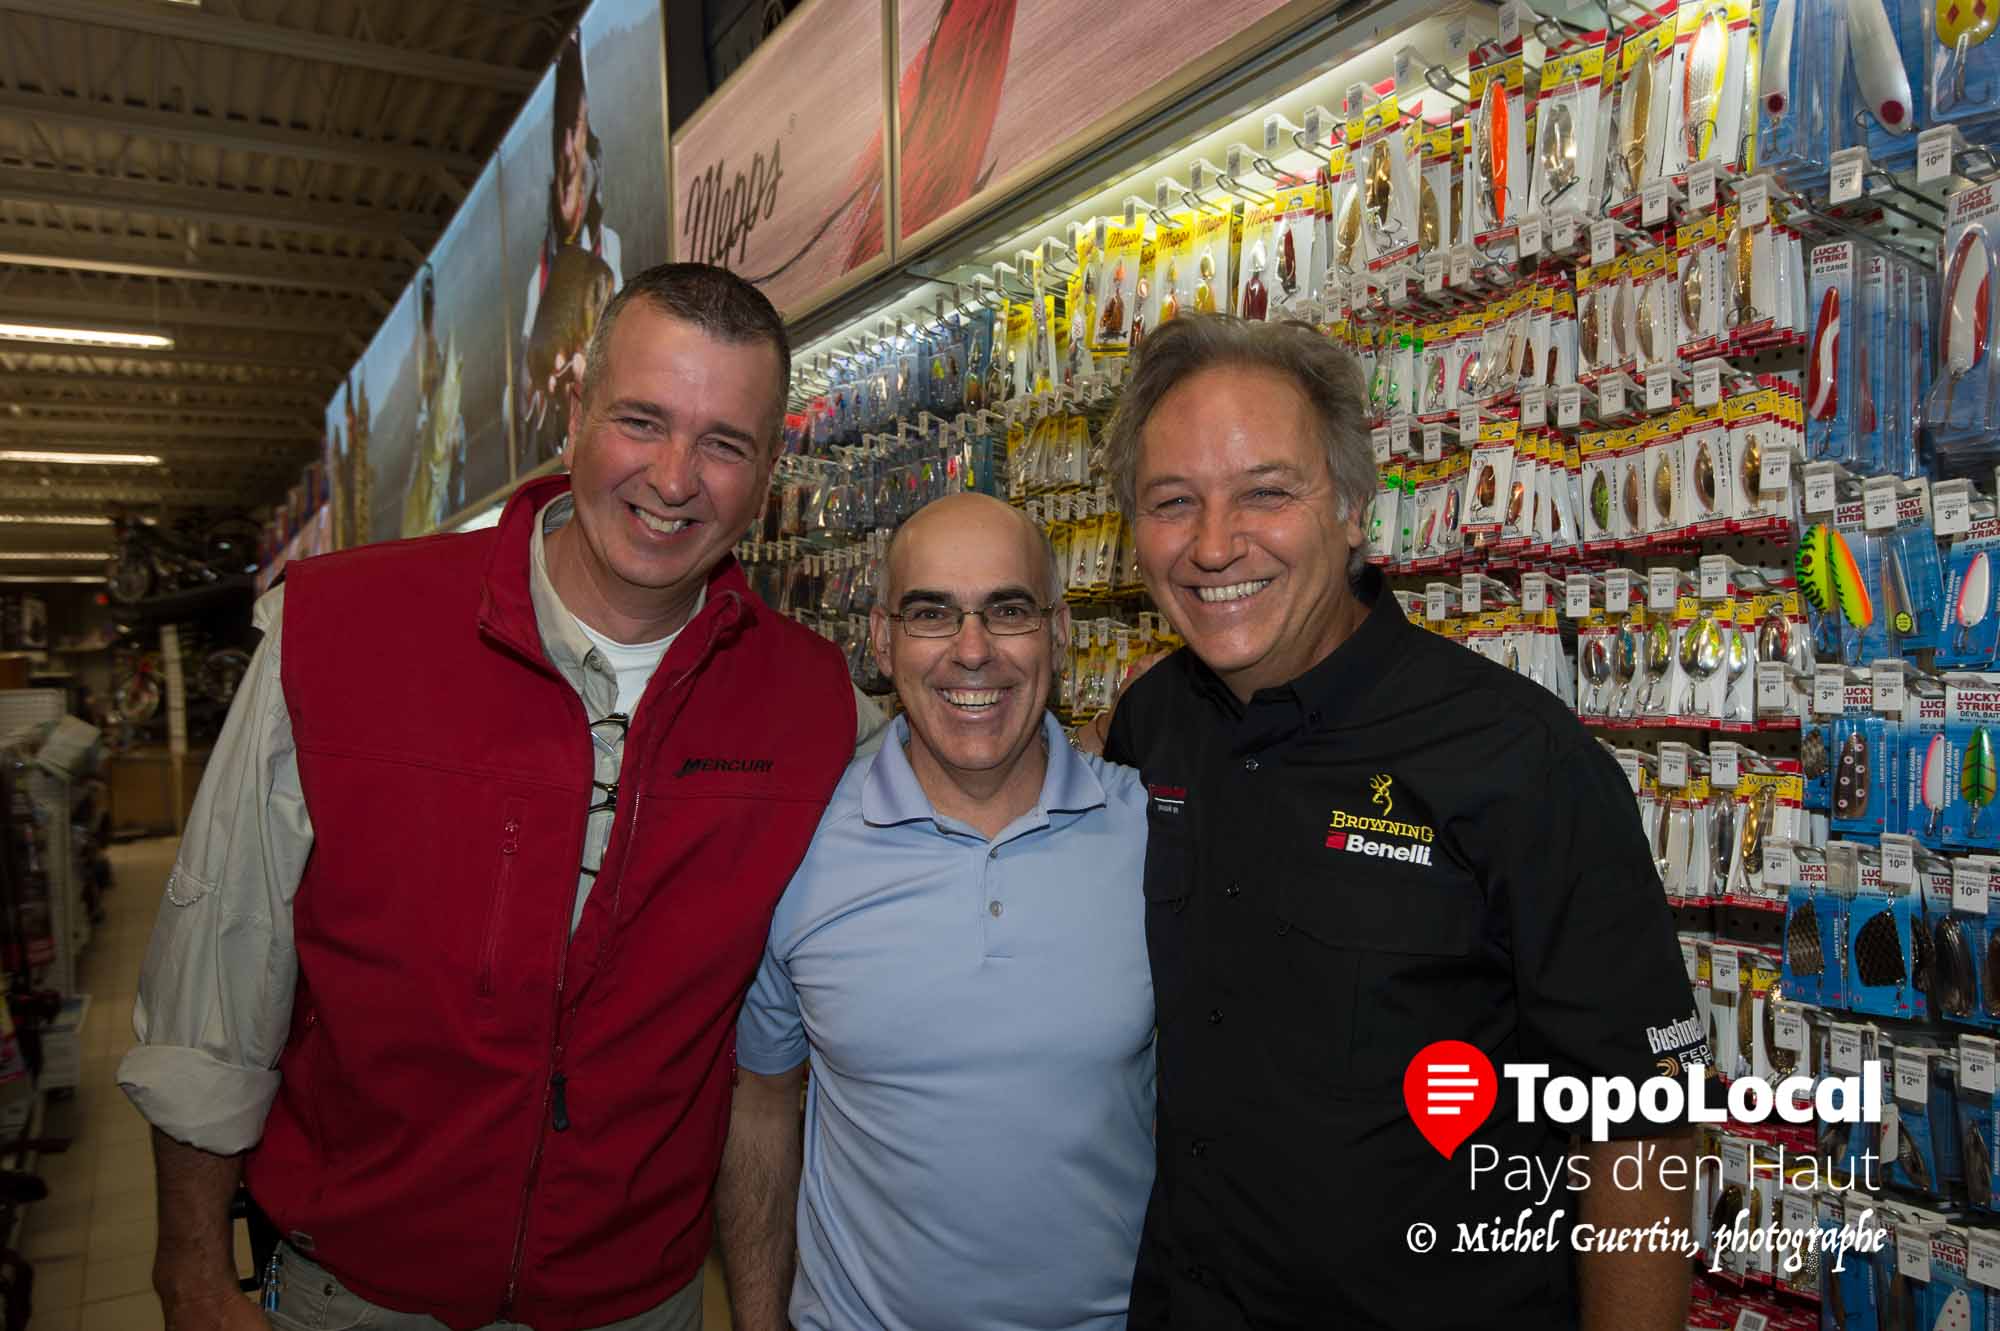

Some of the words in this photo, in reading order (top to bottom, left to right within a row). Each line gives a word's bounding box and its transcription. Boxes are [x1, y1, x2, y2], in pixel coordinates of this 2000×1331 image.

[684, 138, 783, 270] Mepps
[1813, 243, 1847, 257] LUCKY
[1812, 253, 1848, 265] STRIKE
[1957, 692, 2000, 702] LUCKY
[1957, 702, 2000, 712] STRIKE
[1960, 710, 1980, 718] DEVIL
[1983, 711, 2000, 719] BAIT
[672, 757, 774, 778] MERCURY
[1329, 810, 1435, 843] BROWNING
[1345, 833, 1432, 866] Benelli
